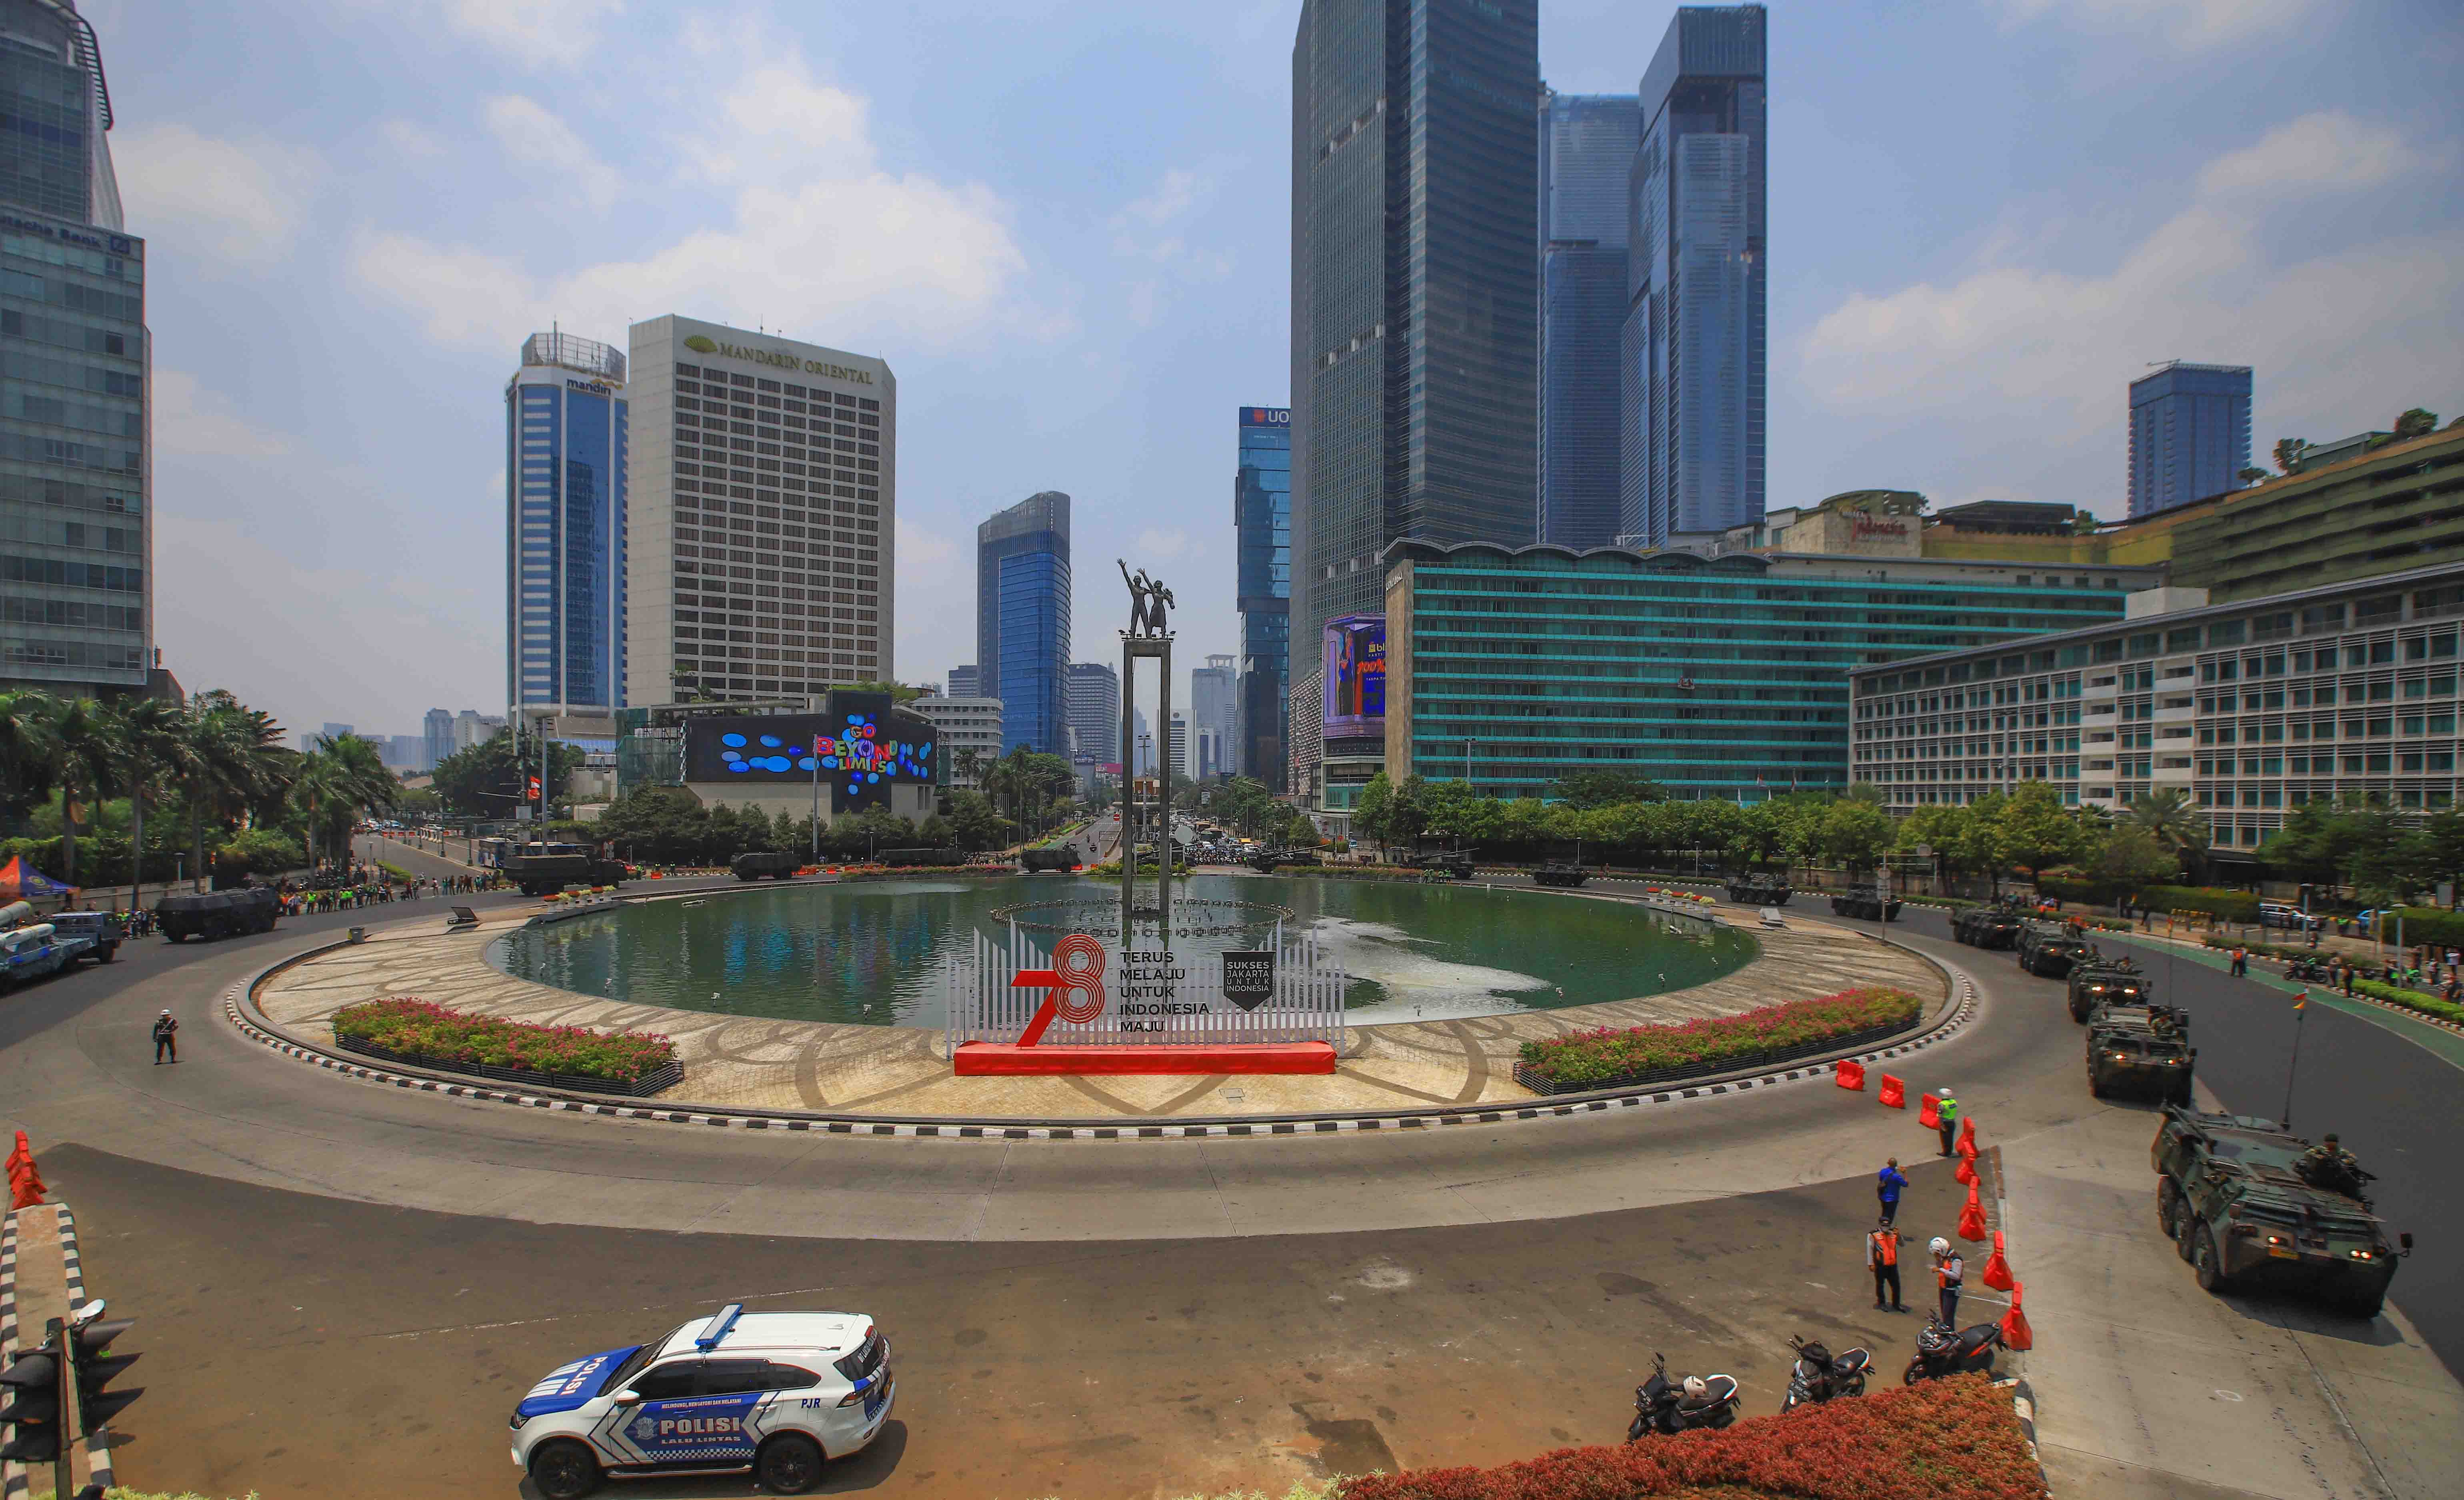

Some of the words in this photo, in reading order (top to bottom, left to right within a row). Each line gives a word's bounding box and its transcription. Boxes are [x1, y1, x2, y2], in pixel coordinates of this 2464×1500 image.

[59, 228, 101, 247] Bank
[720, 342, 800, 370] MANDARIN
[804, 360, 873, 384] ORIENTAL
[566, 378, 611, 395] mandiri
[1268, 410, 1291, 423] UO
[1376, 643, 1385, 652] bl
[850, 726, 876, 738] GO
[813, 736, 898, 761] BEYOND
[839, 757, 886, 773] LIMITS
[1120, 951, 1174, 963] TERUS
[1120, 969, 1185, 980] MELAJU
[1011, 934, 1106, 1047] 78
[1120, 986, 1175, 998] UNTUK
[1120, 1003, 1210, 1015] INDONESIA
[1120, 1021, 1164, 1033] MAJU
[560, 1356, 608, 1395] POLISI
[801, 1398, 820, 1408] PJR
[660, 1417, 740, 1435] POLISI
